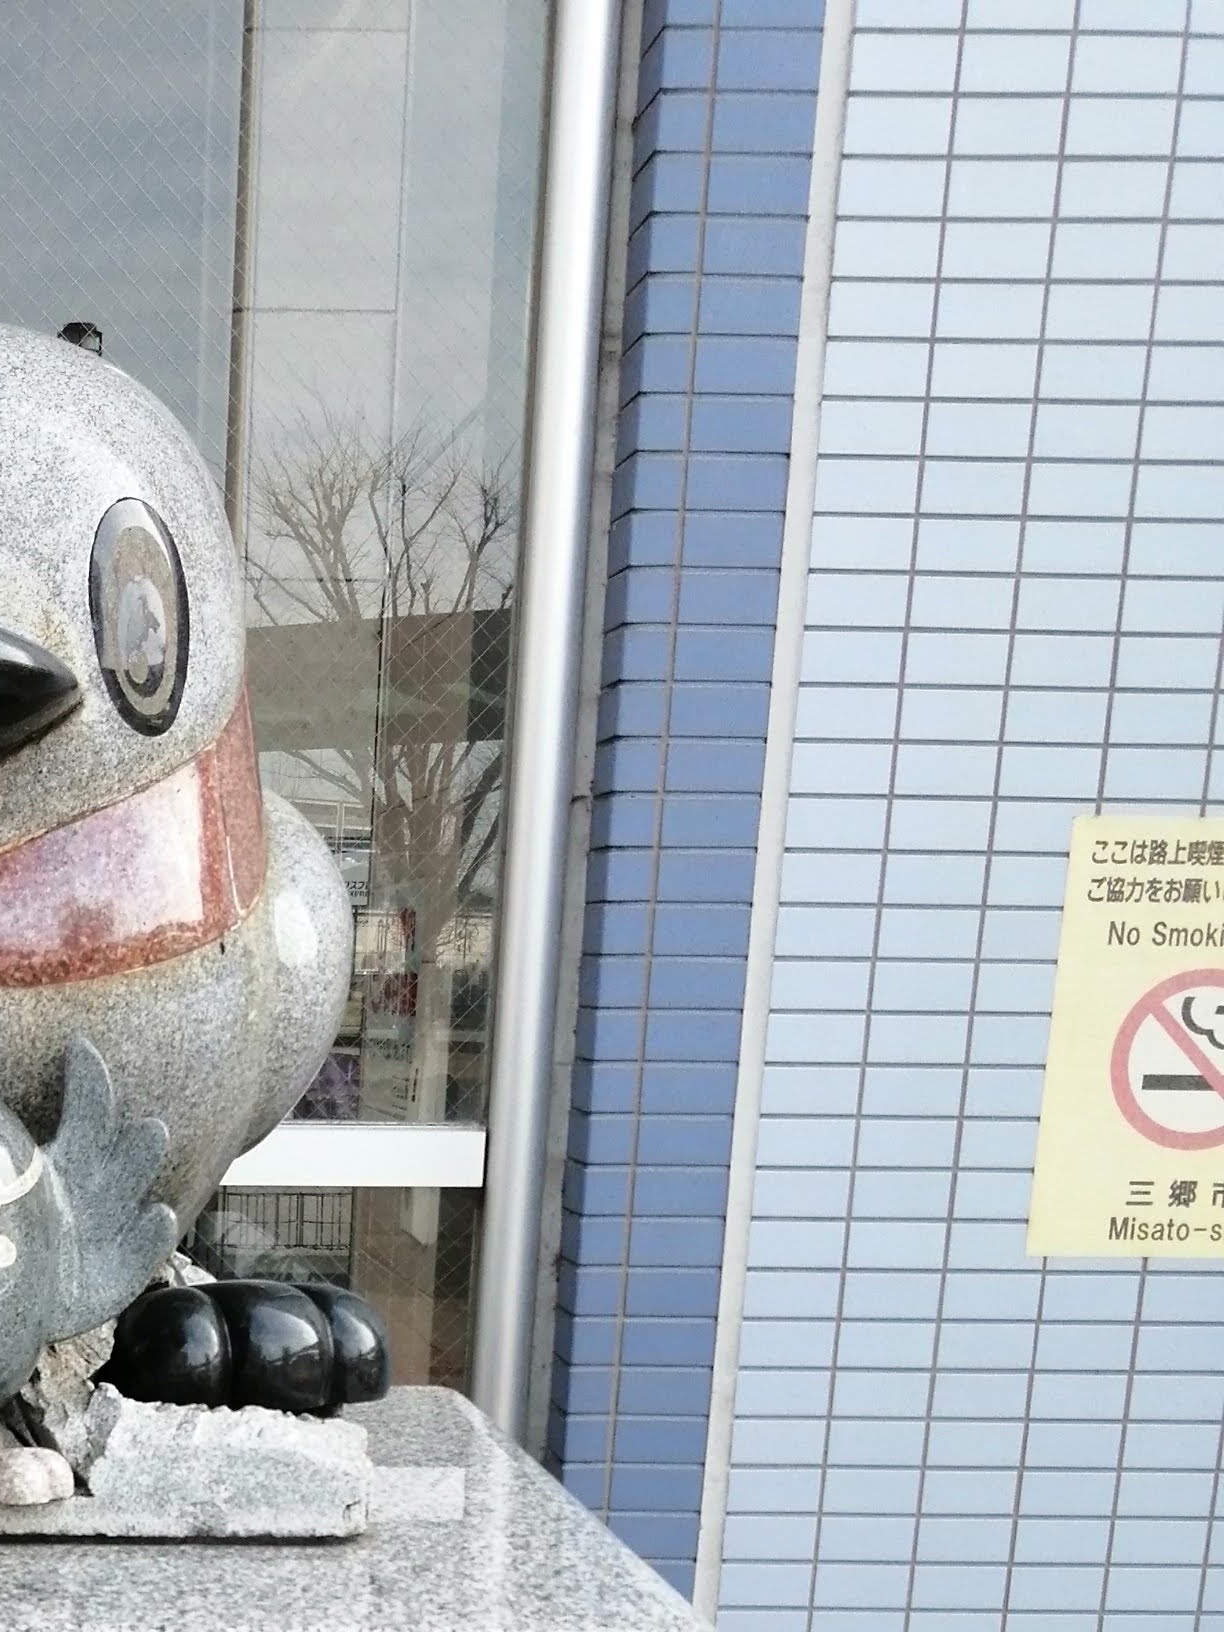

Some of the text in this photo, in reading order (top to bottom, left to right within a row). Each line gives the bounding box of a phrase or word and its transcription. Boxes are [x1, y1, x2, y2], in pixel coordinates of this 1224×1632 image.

[1087, 876, 1224, 903] ご協力をお願い
[1107, 920, 1141, 946] No
